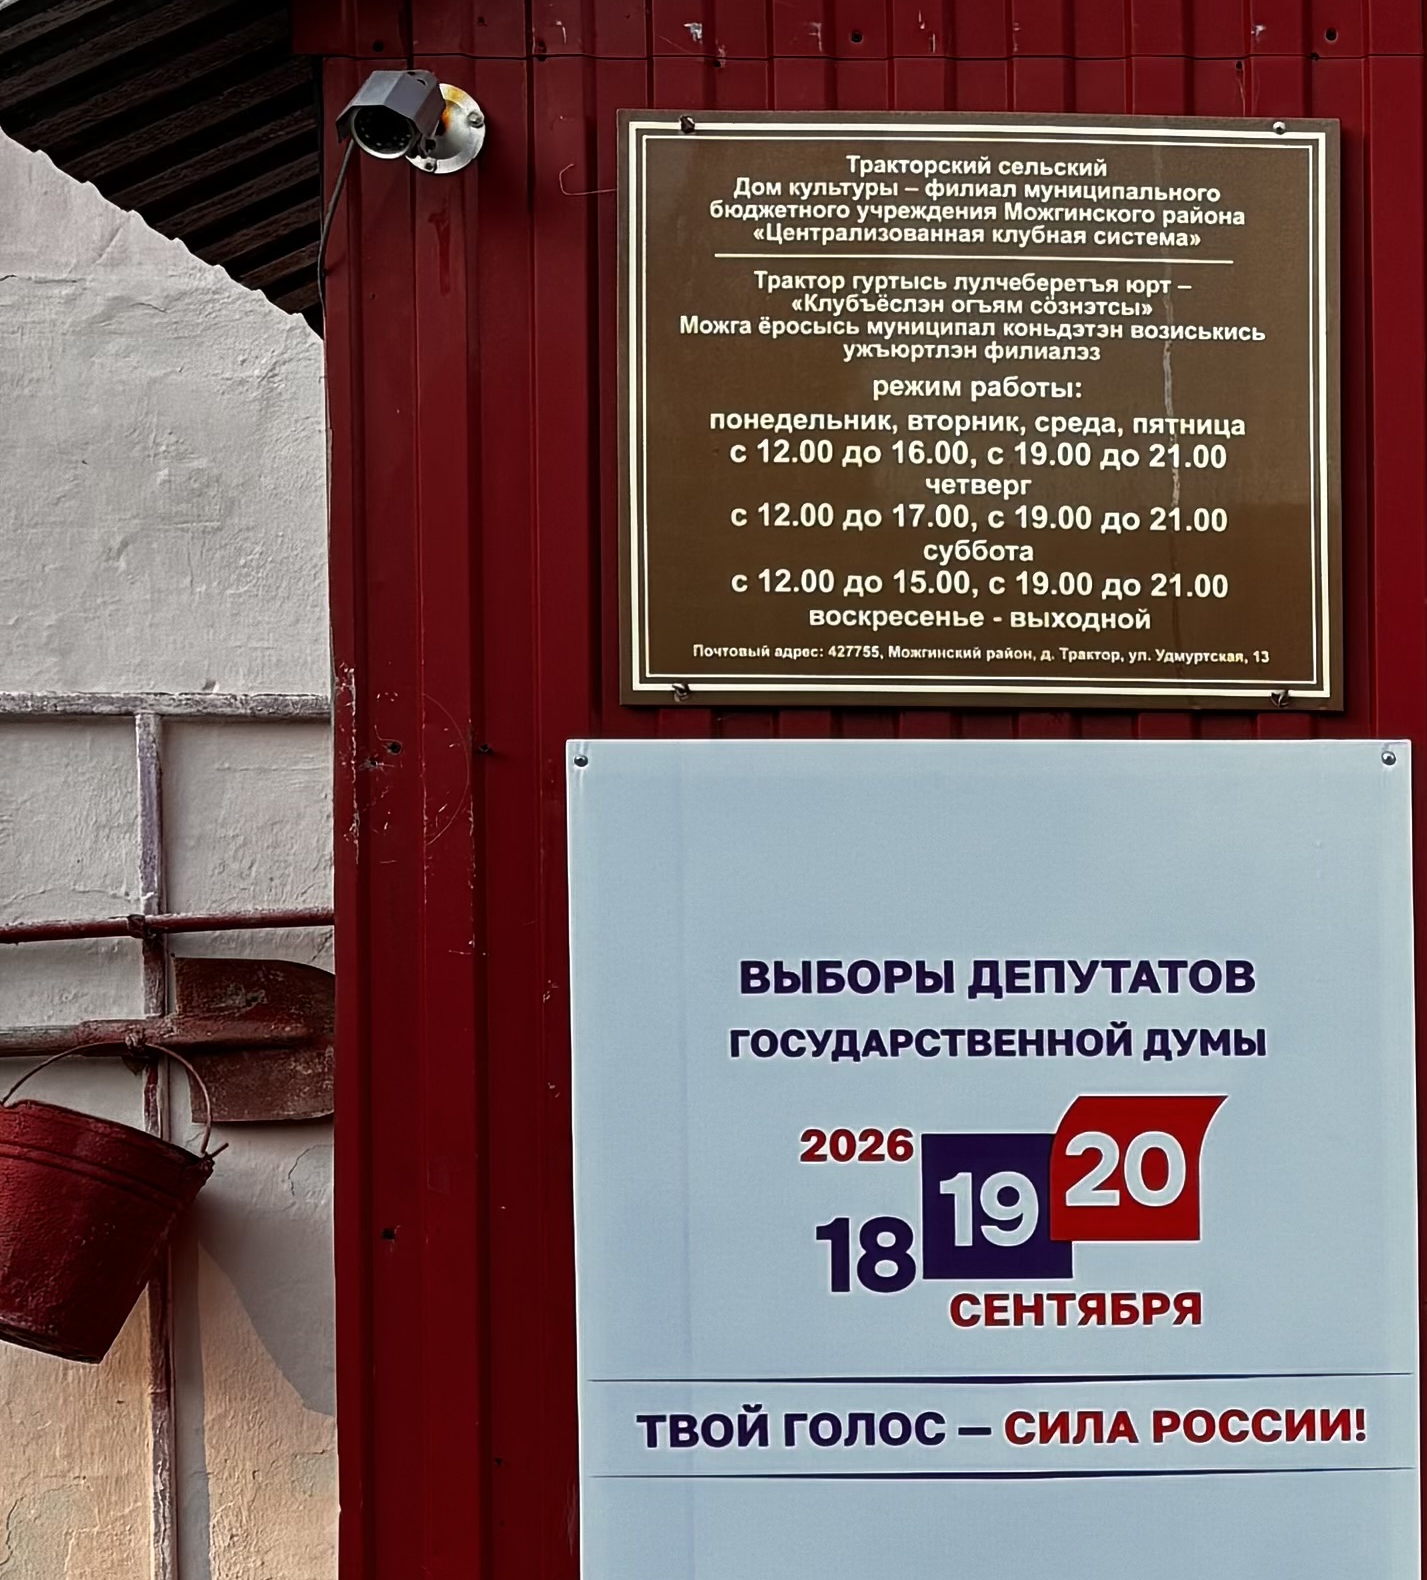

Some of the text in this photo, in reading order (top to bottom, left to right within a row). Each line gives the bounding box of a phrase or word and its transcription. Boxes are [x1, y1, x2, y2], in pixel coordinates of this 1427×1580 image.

[846, 155, 1106, 177] Тракторский сельский
[734, 177, 1220, 202] Дом культуры филиал муниципального
[710, 200, 1244, 227] бюджетного учреждения Можгинского района
[754, 223, 1200, 247] «Централизованная клубная система»
[754, 271, 1171, 300] Трактор гуртысь лулчеберетъя юрт
[792, 293, 943, 316] «Клубъёслэн
[952, 300, 1022, 313] огъям
[681, 316, 1265, 340] Можга ёросысь муниципал коньдэтэн возиськись
[844, 341, 1100, 363] ужъюртлэн филиалэз
[874, 376, 1081, 401] режим работы:
[711, 413, 1245, 438] понедельник, вторник, среда, пятница
[731, 439, 1226, 470] с 12.00 до 16.00, с 19.00 до 21.00
[926, 479, 1031, 500] четверг
[731, 503, 1227, 533] с 12.00 до 17.00, с 19.00 до 21.00
[924, 540, 1033, 565] суббота
[732, 569, 1228, 600] с 12.00 до 15.00, с 19.00 до 21.00
[810, 609, 1150, 632] воскресенье выходной
[694, 645, 1269, 664] Почтовый адрес: 427755, Можгинский район, д. Трактор, ул. Удмуртская, 13
[741, 960, 1255, 999] ВЫБОРЫ ДЕПУТАТОВ
[731, 1021, 1265, 1062] ГОСУДАРСТВЕННОЙ ДУМЫ
[801, 1128, 913, 1162] 2026
[1066, 1131, 1186, 1206] 20
[940, 1171, 1038, 1246] 19
[816, 1217, 916, 1292] 18
[951, 1292, 1201, 1327] СЕНТЯБРЯ
[637, 1404, 1365, 1447] ТВОЙ ГОЛОС СИЛА РОССИИ!
